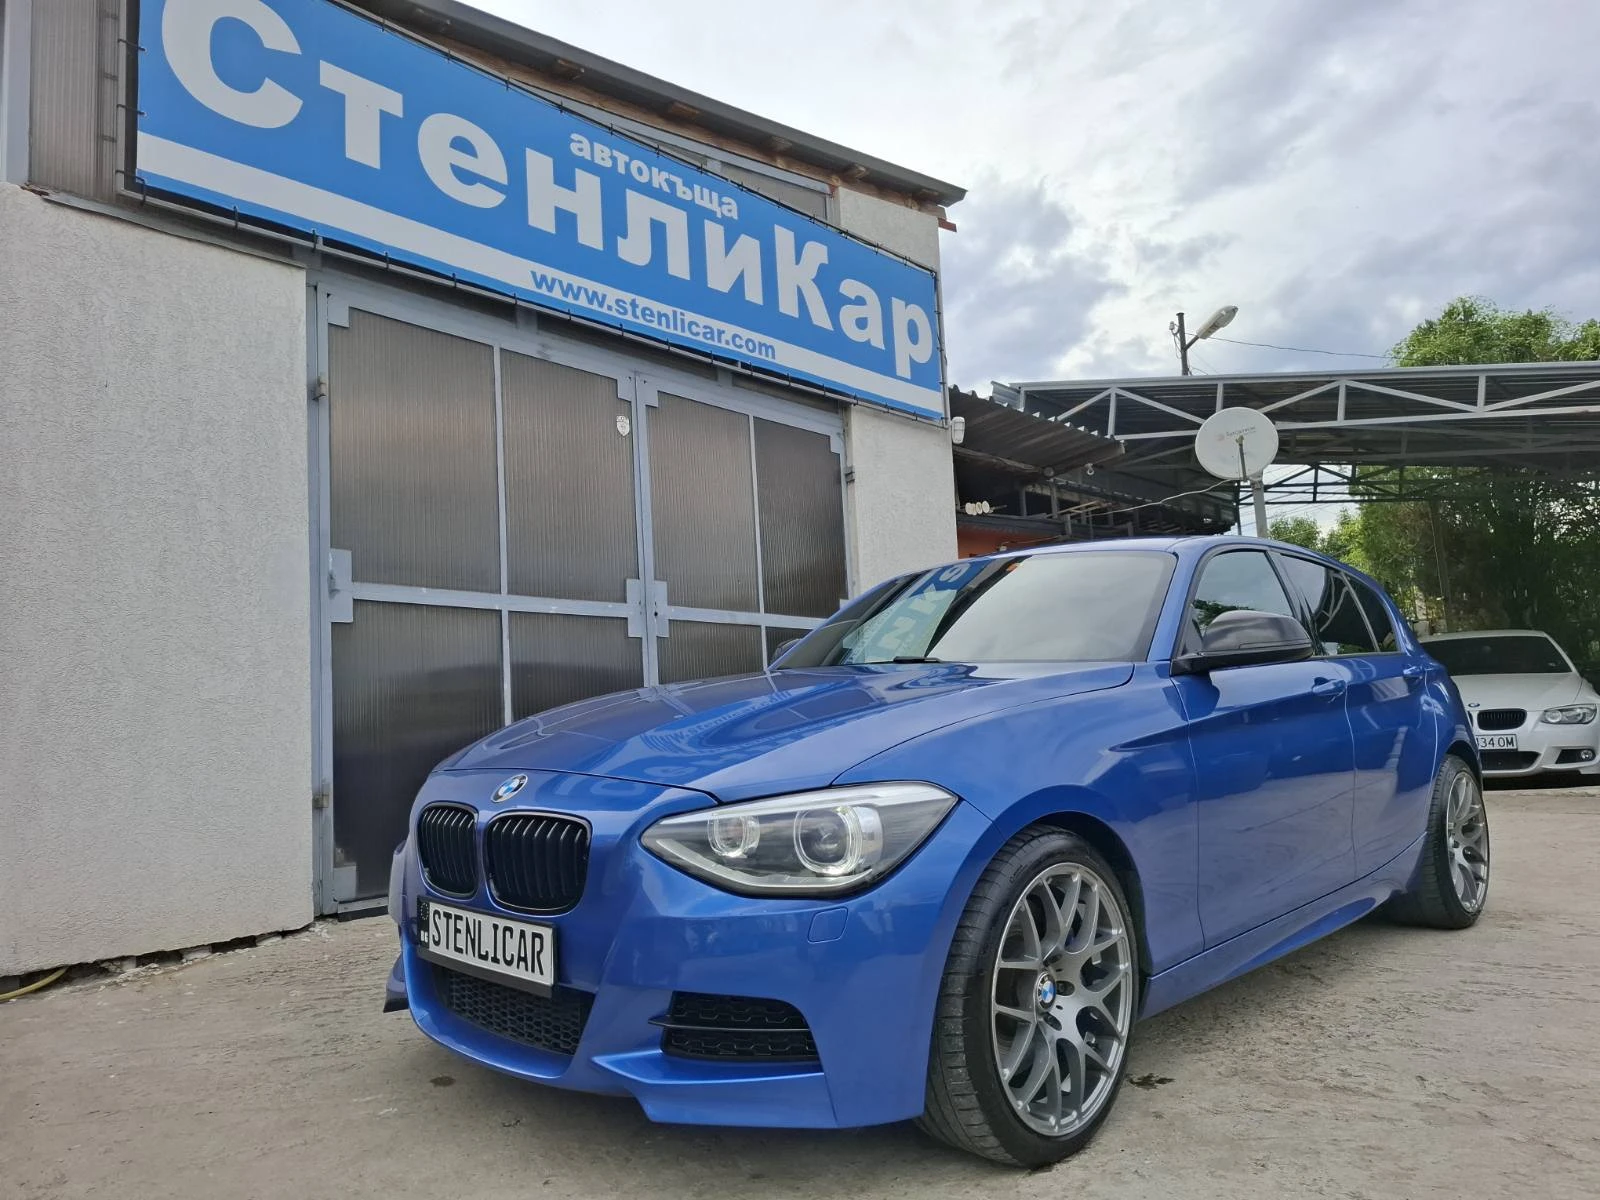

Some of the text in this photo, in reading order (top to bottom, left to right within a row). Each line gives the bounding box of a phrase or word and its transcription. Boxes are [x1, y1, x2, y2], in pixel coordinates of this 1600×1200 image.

[162, 0, 933, 380] СтенлиКар
[570, 131, 739, 220] автокъща
[531, 270, 776, 360] www.stenlicar.com
[432, 909, 544, 976] STENLICAR
